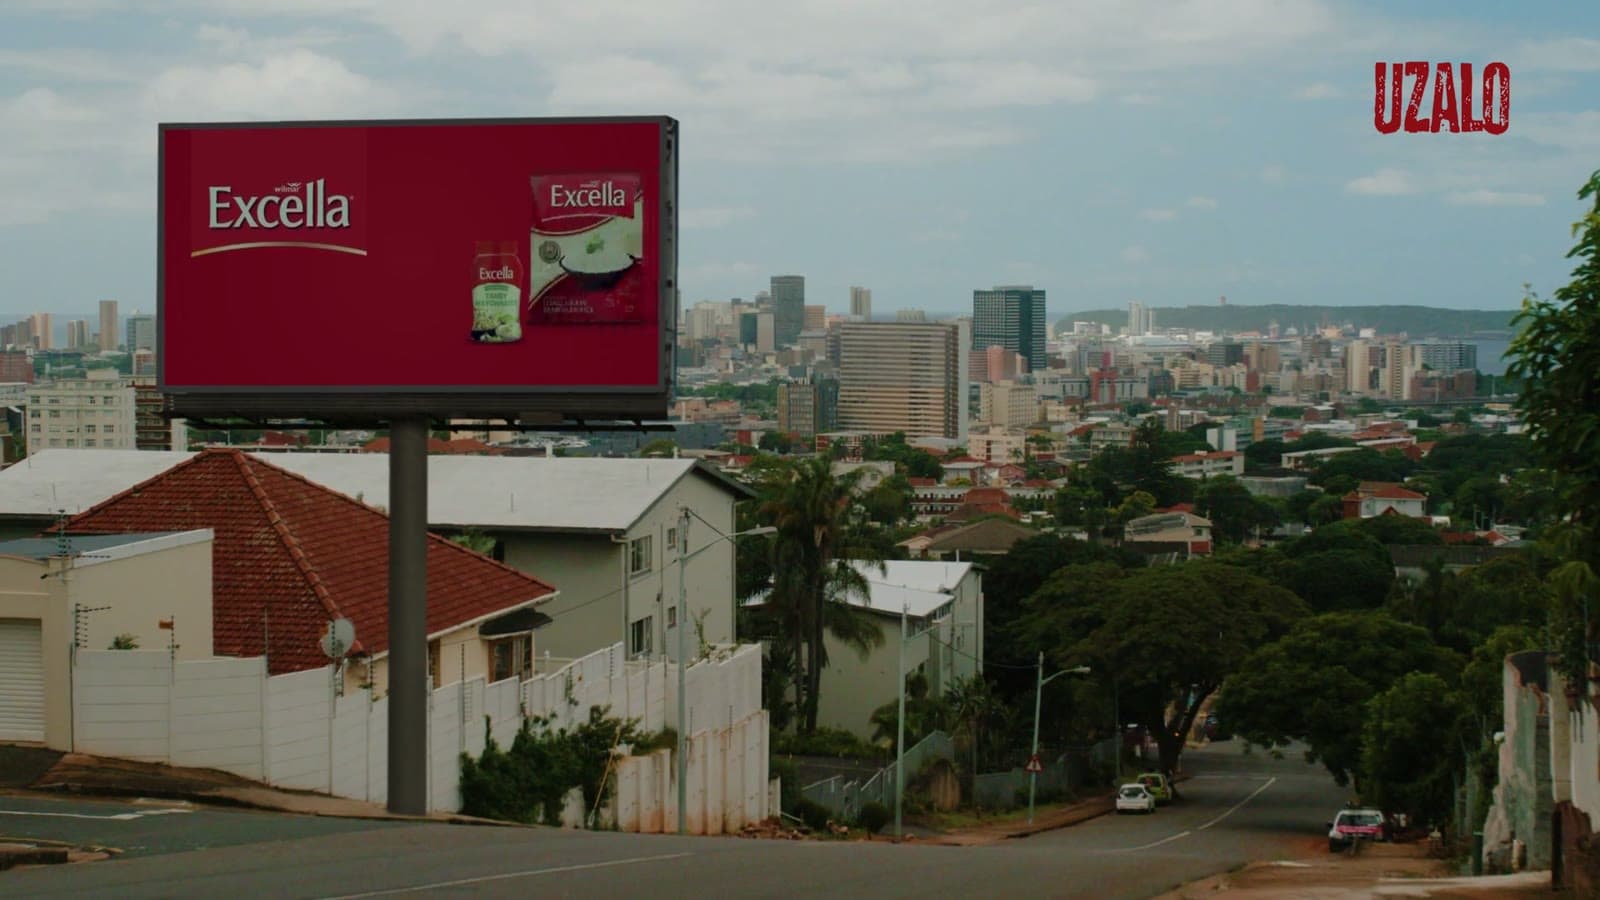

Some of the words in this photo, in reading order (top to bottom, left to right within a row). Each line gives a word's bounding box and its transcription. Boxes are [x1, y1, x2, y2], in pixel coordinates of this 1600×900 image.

[209, 178, 351, 229] Excella
[551, 181, 626, 208] Excella
[479, 266, 514, 281] Excella
